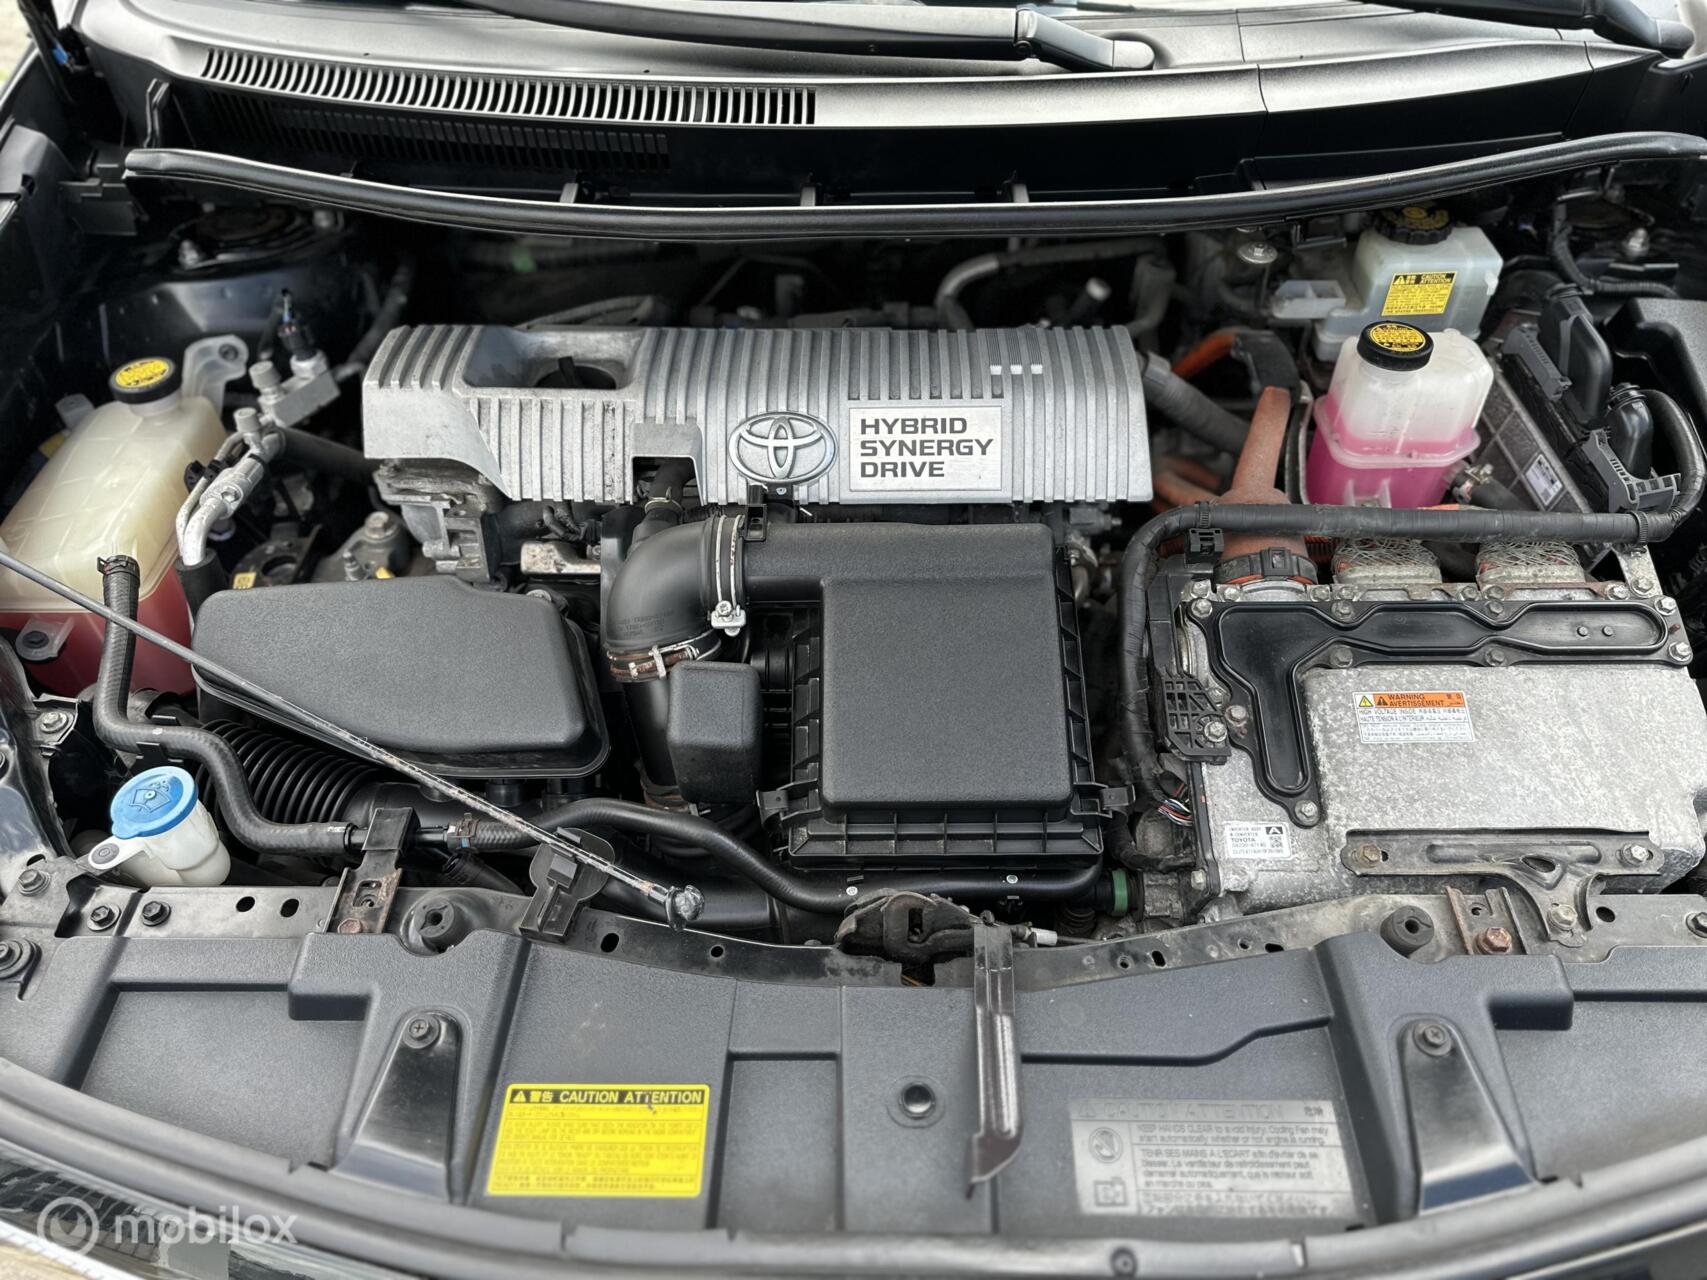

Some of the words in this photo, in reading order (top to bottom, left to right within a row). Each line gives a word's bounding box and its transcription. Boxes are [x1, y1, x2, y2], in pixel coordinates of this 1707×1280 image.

[860, 417, 968, 435] HYBRID
[860, 438, 994, 457] SYNERGY
[860, 461, 945, 478] DRIVE
[559, 1090, 620, 1103] CAUTION
[623, 1090, 702, 1104] ATTENTION
